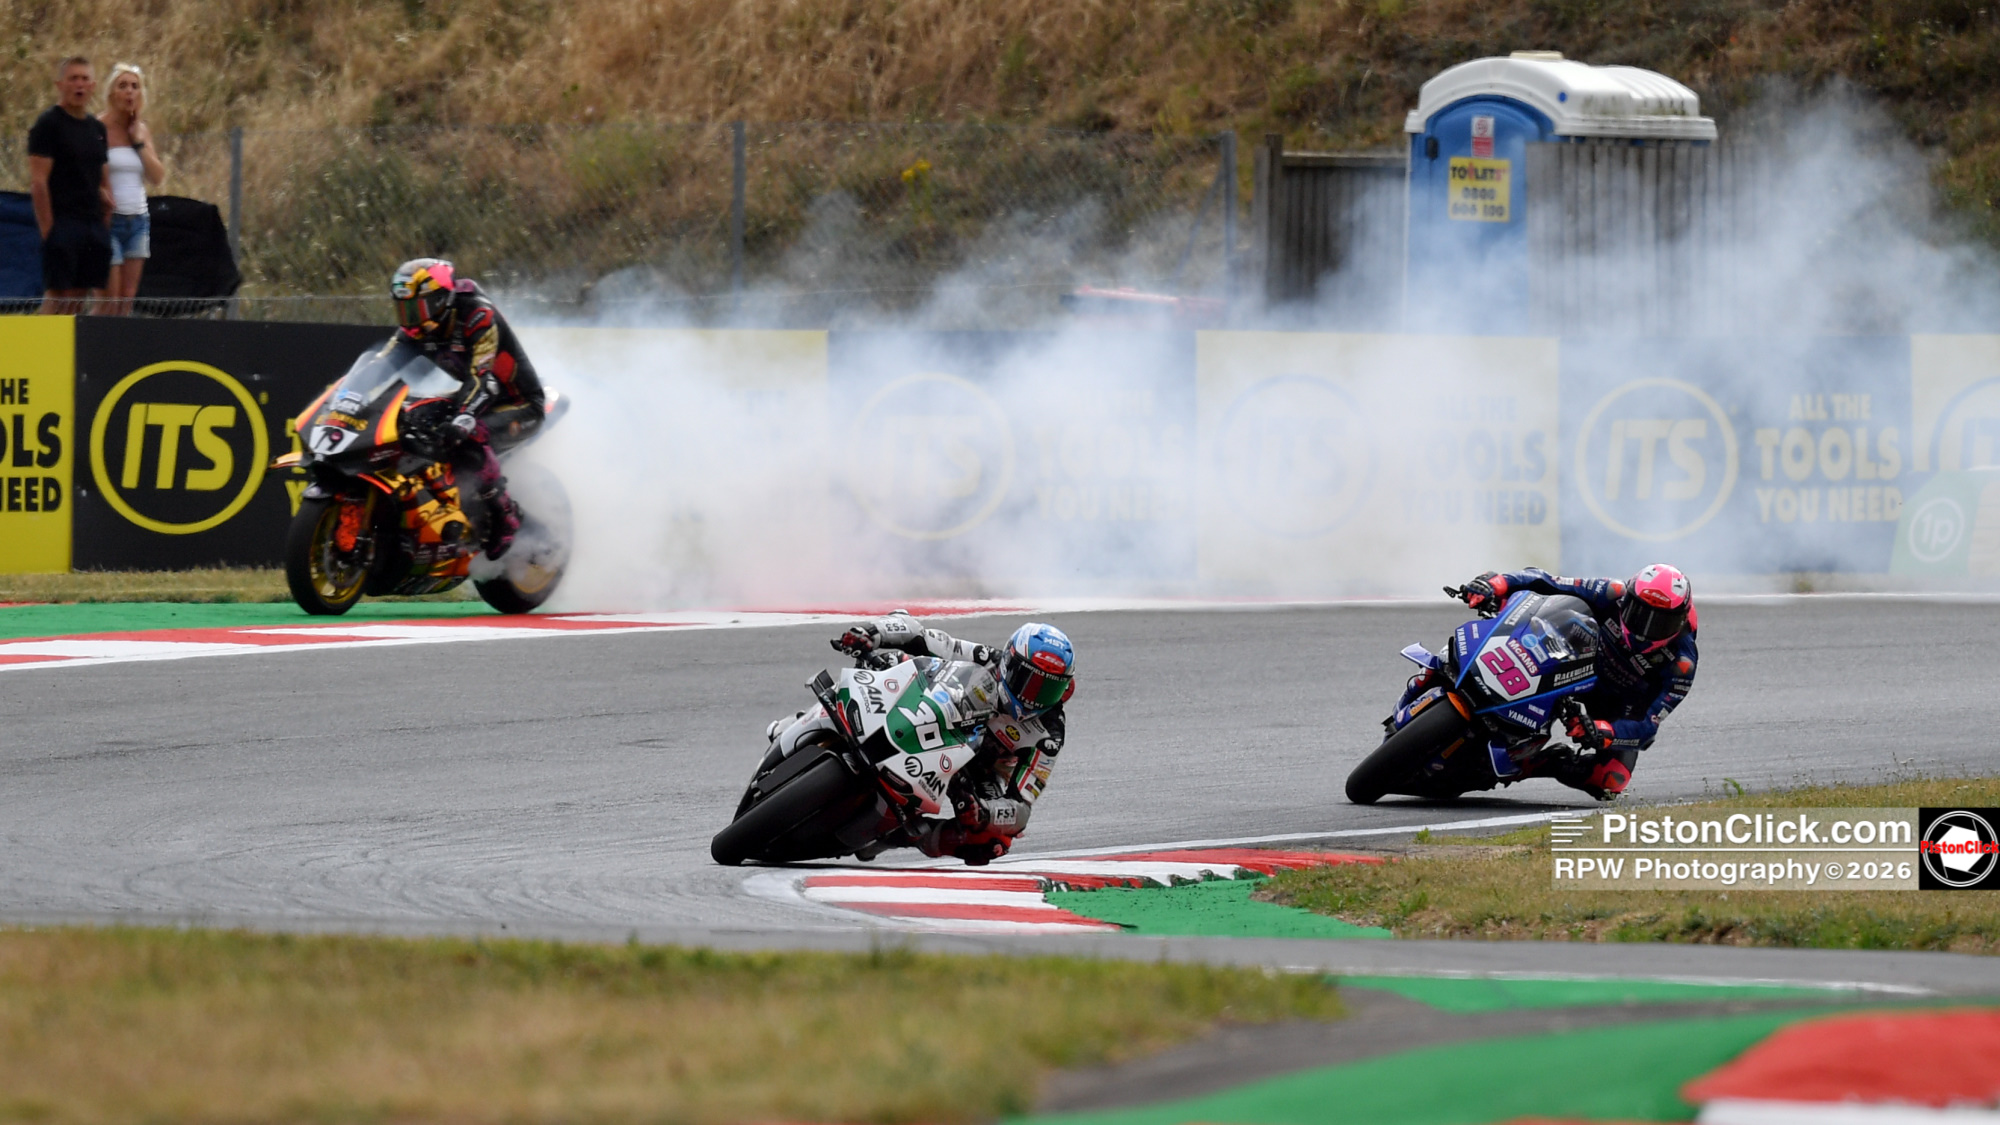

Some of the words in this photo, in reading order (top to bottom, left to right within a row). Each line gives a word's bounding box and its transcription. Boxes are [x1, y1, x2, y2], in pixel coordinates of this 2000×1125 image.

[1789, 393, 1828, 420] ALL
[1832, 394, 1872, 420] THE
[0, 411, 62, 469] LS
[122, 403, 236, 490] ITS
[876, 415, 983, 498] ITS
[1755, 427, 1900, 481] TOOLS
[1605, 419, 1707, 500] ITS
[0, 476, 62, 512] EED
[1474, 491, 1548, 526] NEED
[1755, 488, 1820, 523] YOU
[1828, 487, 1902, 522] NEED
[1920, 511, 1955, 550] 1p
[1456, 627, 1468, 656] YAMAHA
[1507, 638, 1540, 675] McAMS
[1480, 646, 1531, 696] 28
[867, 685, 887, 714] AJN
[897, 700, 945, 750] 30
[1507, 709, 1538, 730] YAMAHA
[921, 770, 946, 796] AJN
